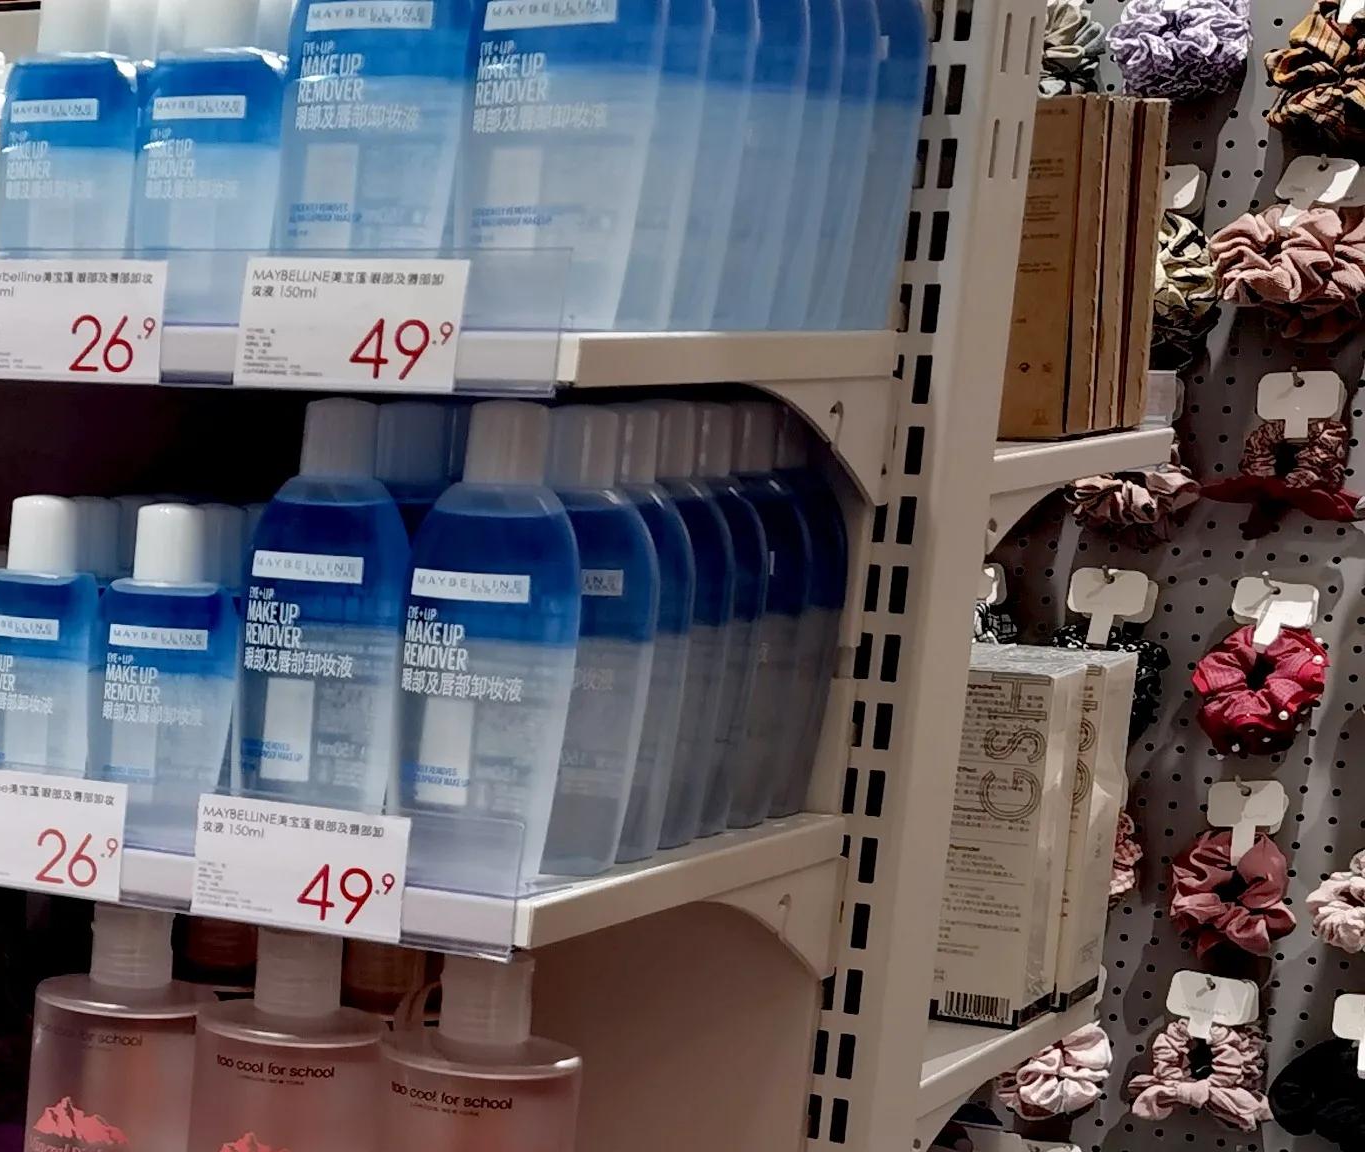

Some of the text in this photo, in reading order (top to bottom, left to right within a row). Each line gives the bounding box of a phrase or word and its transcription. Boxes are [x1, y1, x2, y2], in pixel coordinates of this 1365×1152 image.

[301, 54, 363, 76] MAKE UP
[521, 52, 546, 77] UP
[298, 78, 364, 103] REMOVER
[475, 79, 549, 105] REMOVER
[247, 599, 300, 624] MAKE UP
[246, 621, 302, 648] REMOVER
[405, 619, 464, 646] MAKE UP
[244, 647, 354, 680] 眼部及唇部卸妆液
[403, 641, 468, 671] REMOVER
[103, 681, 161, 704] REMOVER
[401, 668, 524, 703] 眼部及唇部卸妆液
[216, 1054, 335, 1080] too cool for school
[391, 1080, 513, 1111] too cool for school
